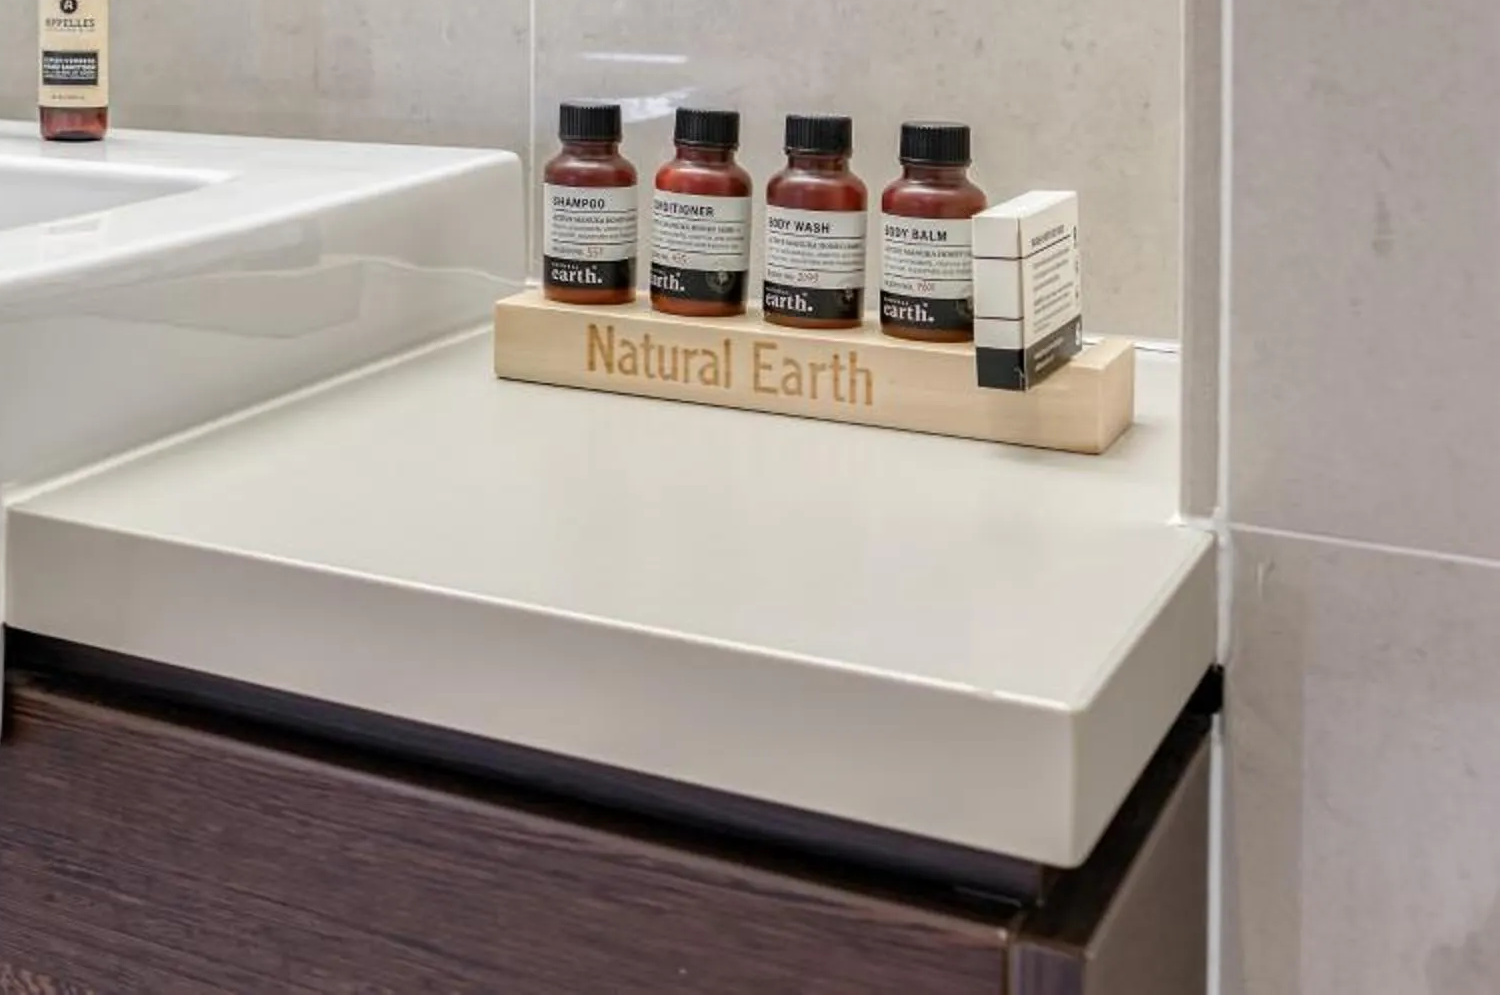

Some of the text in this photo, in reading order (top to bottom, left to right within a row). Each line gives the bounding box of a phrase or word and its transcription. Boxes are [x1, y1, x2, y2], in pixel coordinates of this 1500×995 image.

[553, 196, 606, 210] SHAMPOO
[768, 217, 830, 234] BODY WASH
[884, 224, 948, 242] BODY BALM
[551, 267, 603, 284] earth.
[586, 323, 873, 406] Natural Earth
